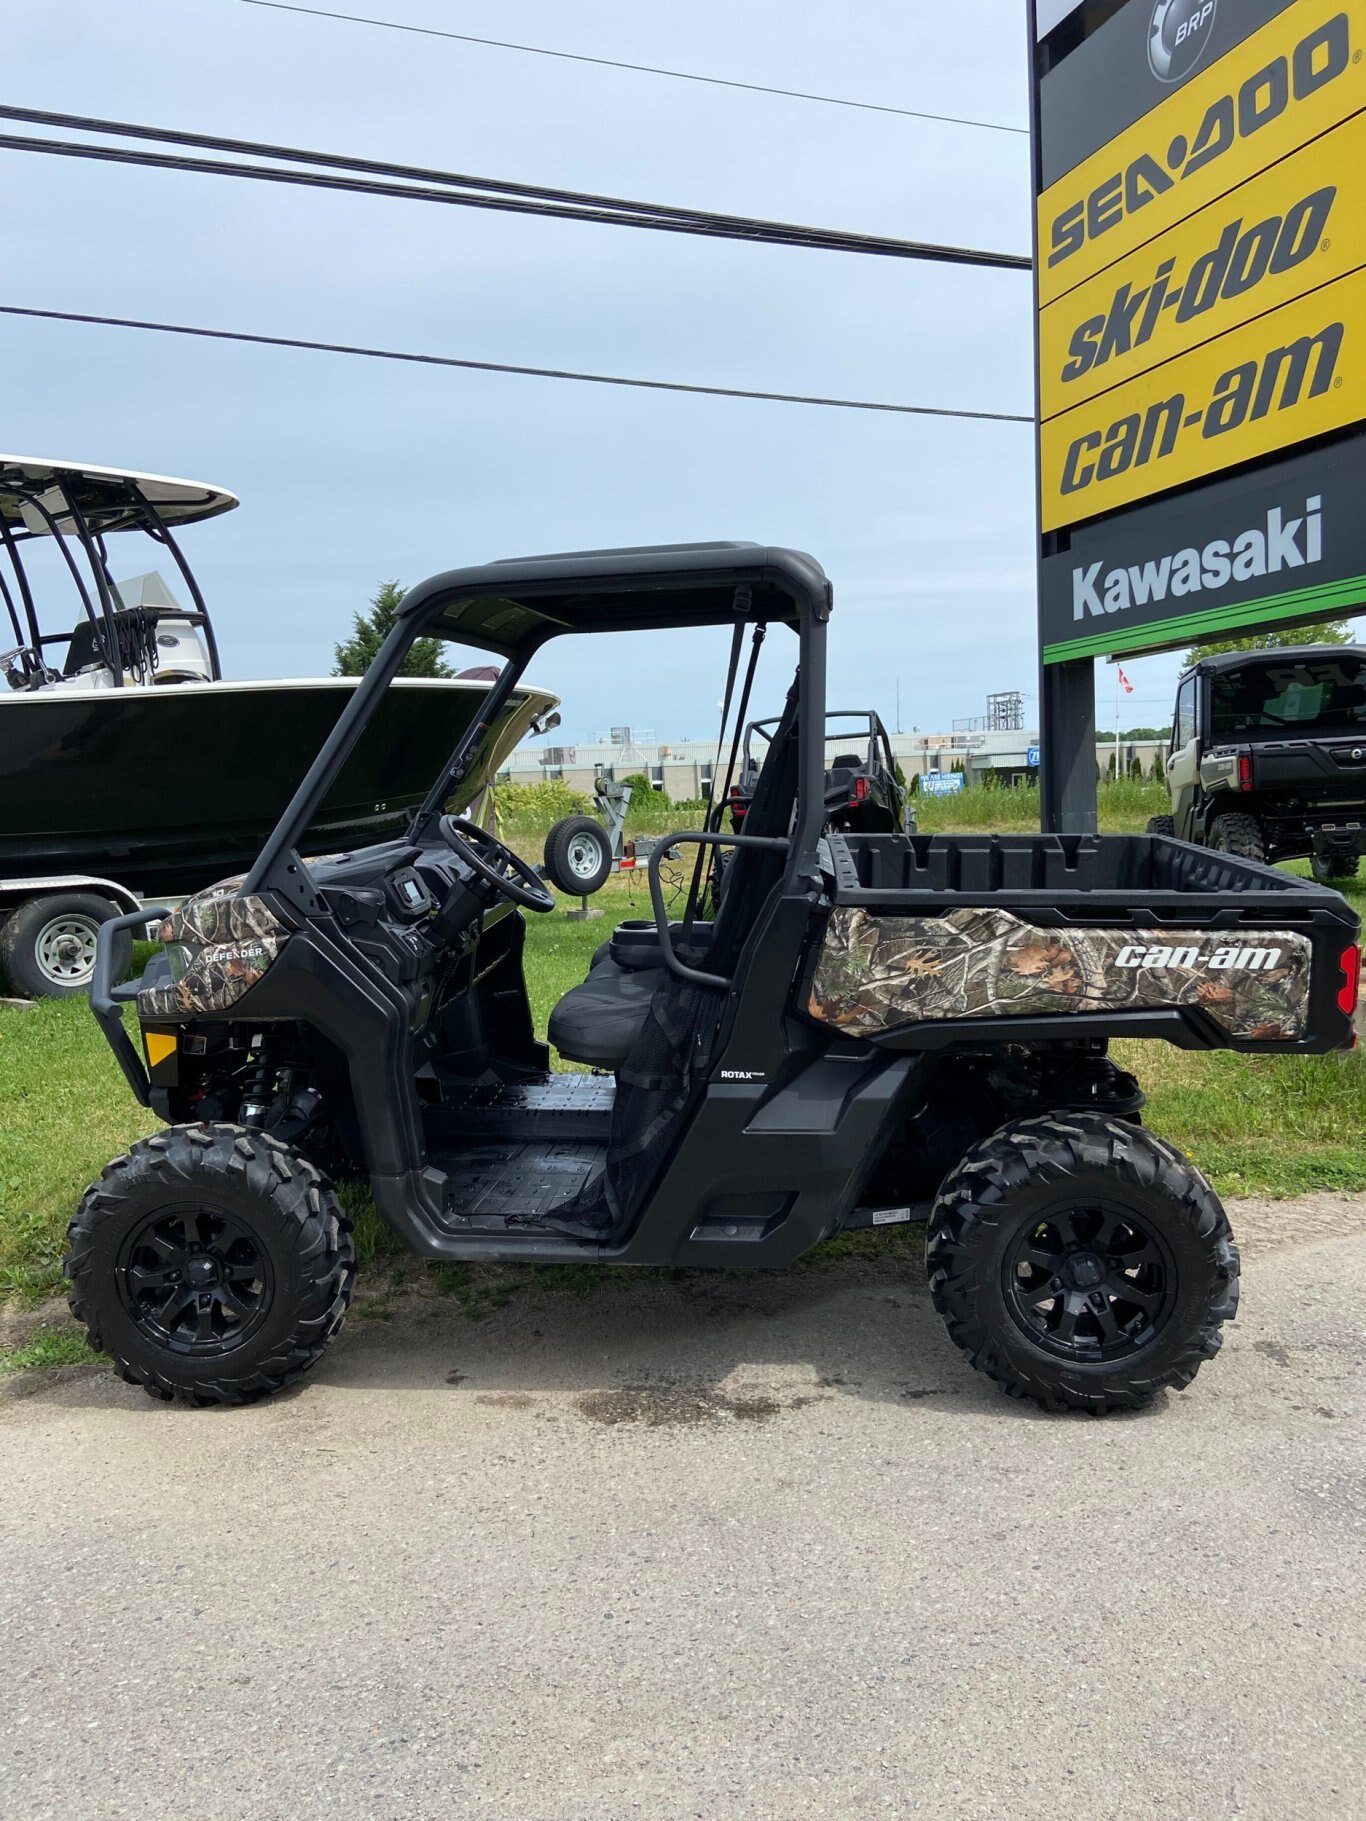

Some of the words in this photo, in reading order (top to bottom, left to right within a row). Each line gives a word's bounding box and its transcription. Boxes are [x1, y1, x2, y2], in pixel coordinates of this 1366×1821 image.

[1175, 1, 1213, 47] BRP
[1060, 322, 1344, 495] can-am
[1073, 494, 1322, 621] Kawasaki
[205, 947, 263, 962] DEFENDER
[1115, 945, 1282, 970] can-am
[721, 1070, 752, 1079] ROTAX
